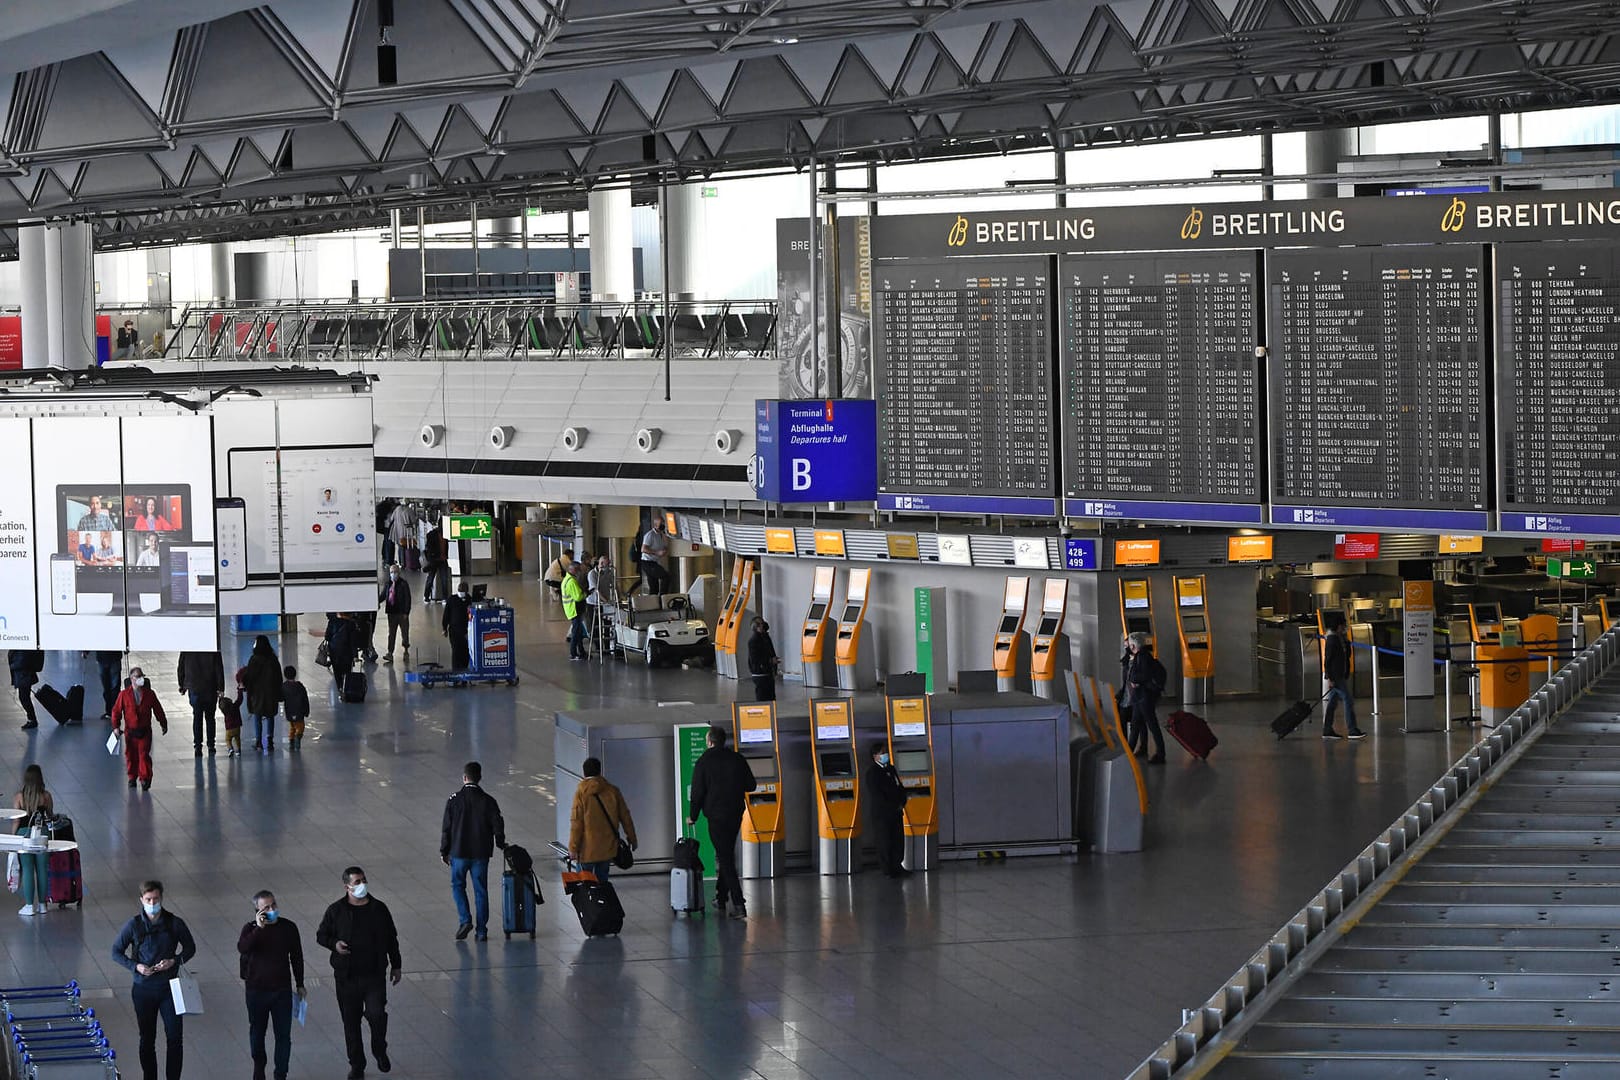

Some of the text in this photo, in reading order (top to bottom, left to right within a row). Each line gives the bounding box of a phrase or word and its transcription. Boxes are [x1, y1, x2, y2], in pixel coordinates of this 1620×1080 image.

[1213, 210, 1344, 235] BREITLING
[1476, 201, 1620, 228] BREITLING
[976, 219, 1094, 242] BREITLING
[790, 425, 834, 433] Abflughalle
[790, 435, 847, 445] Departures hall
[792, 458, 812, 490] B
